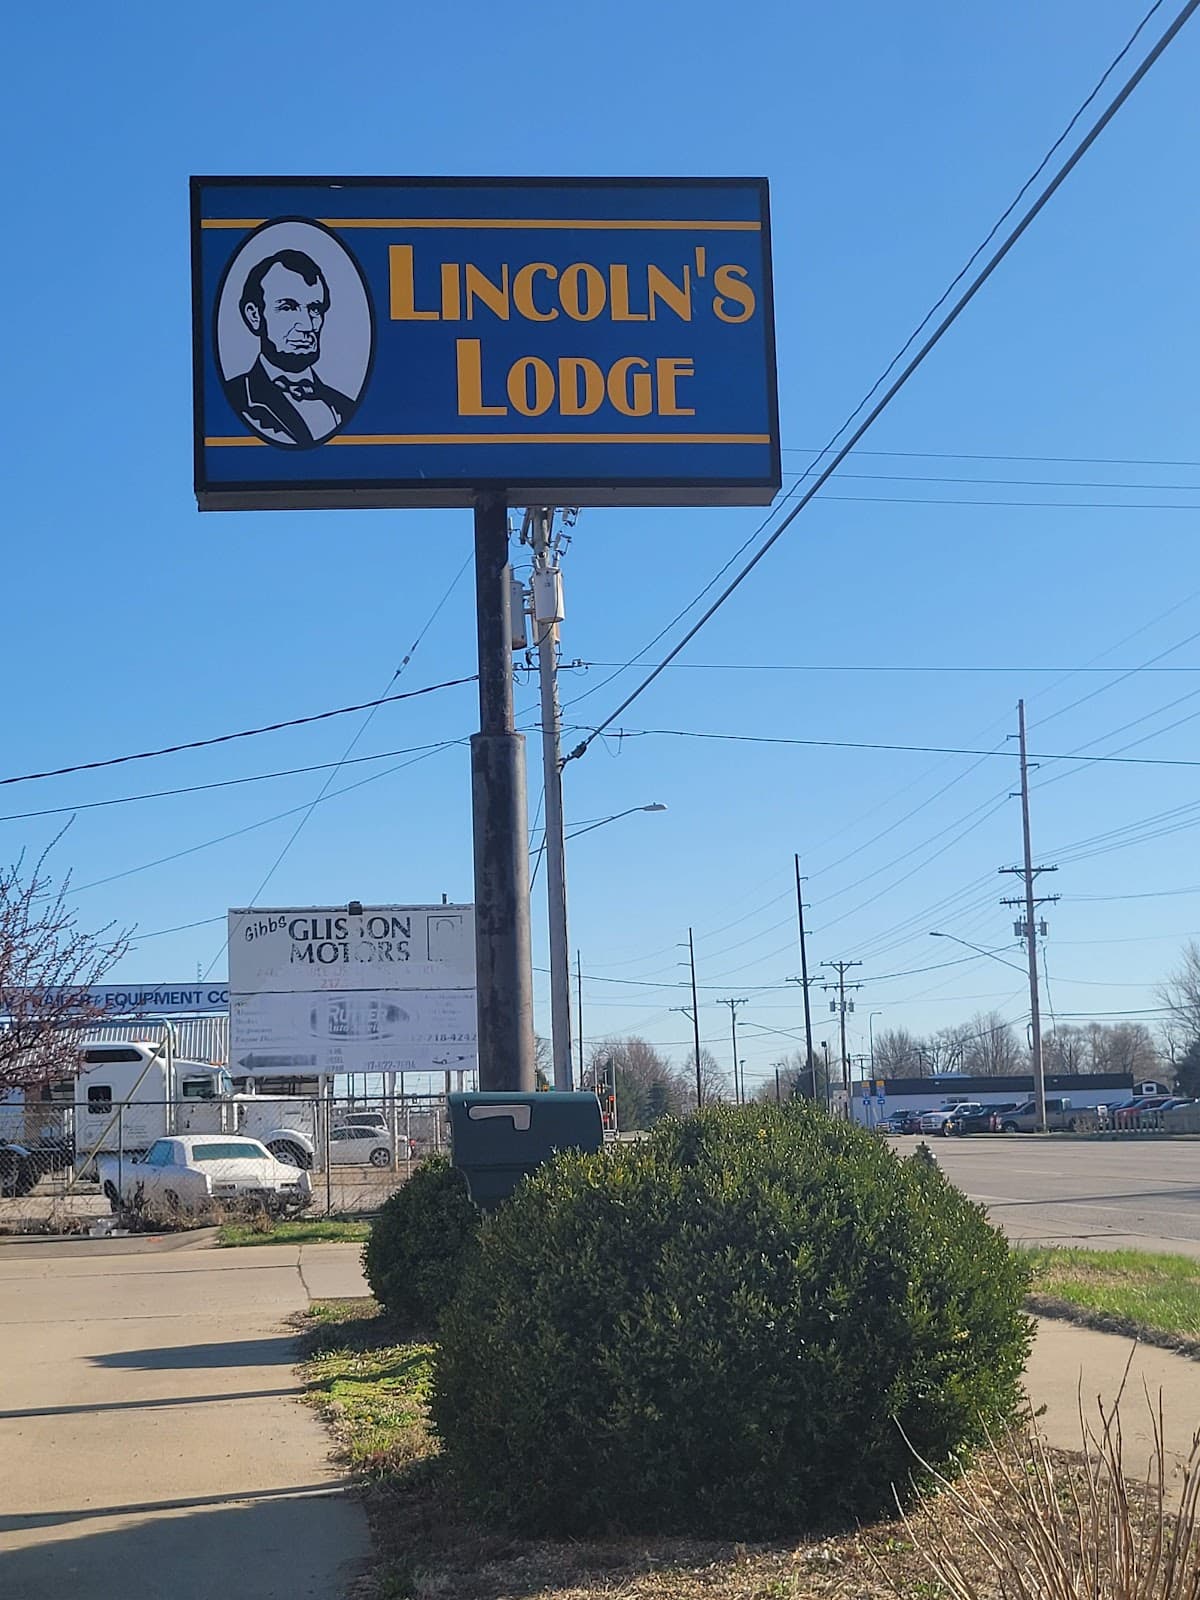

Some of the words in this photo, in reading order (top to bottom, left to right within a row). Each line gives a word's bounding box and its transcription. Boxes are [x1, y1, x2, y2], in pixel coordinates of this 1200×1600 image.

[456, 338, 696, 417] LODGE
[245, 915, 287, 942] Gibbs
[105, 990, 203, 1007] EQUIPMENT
